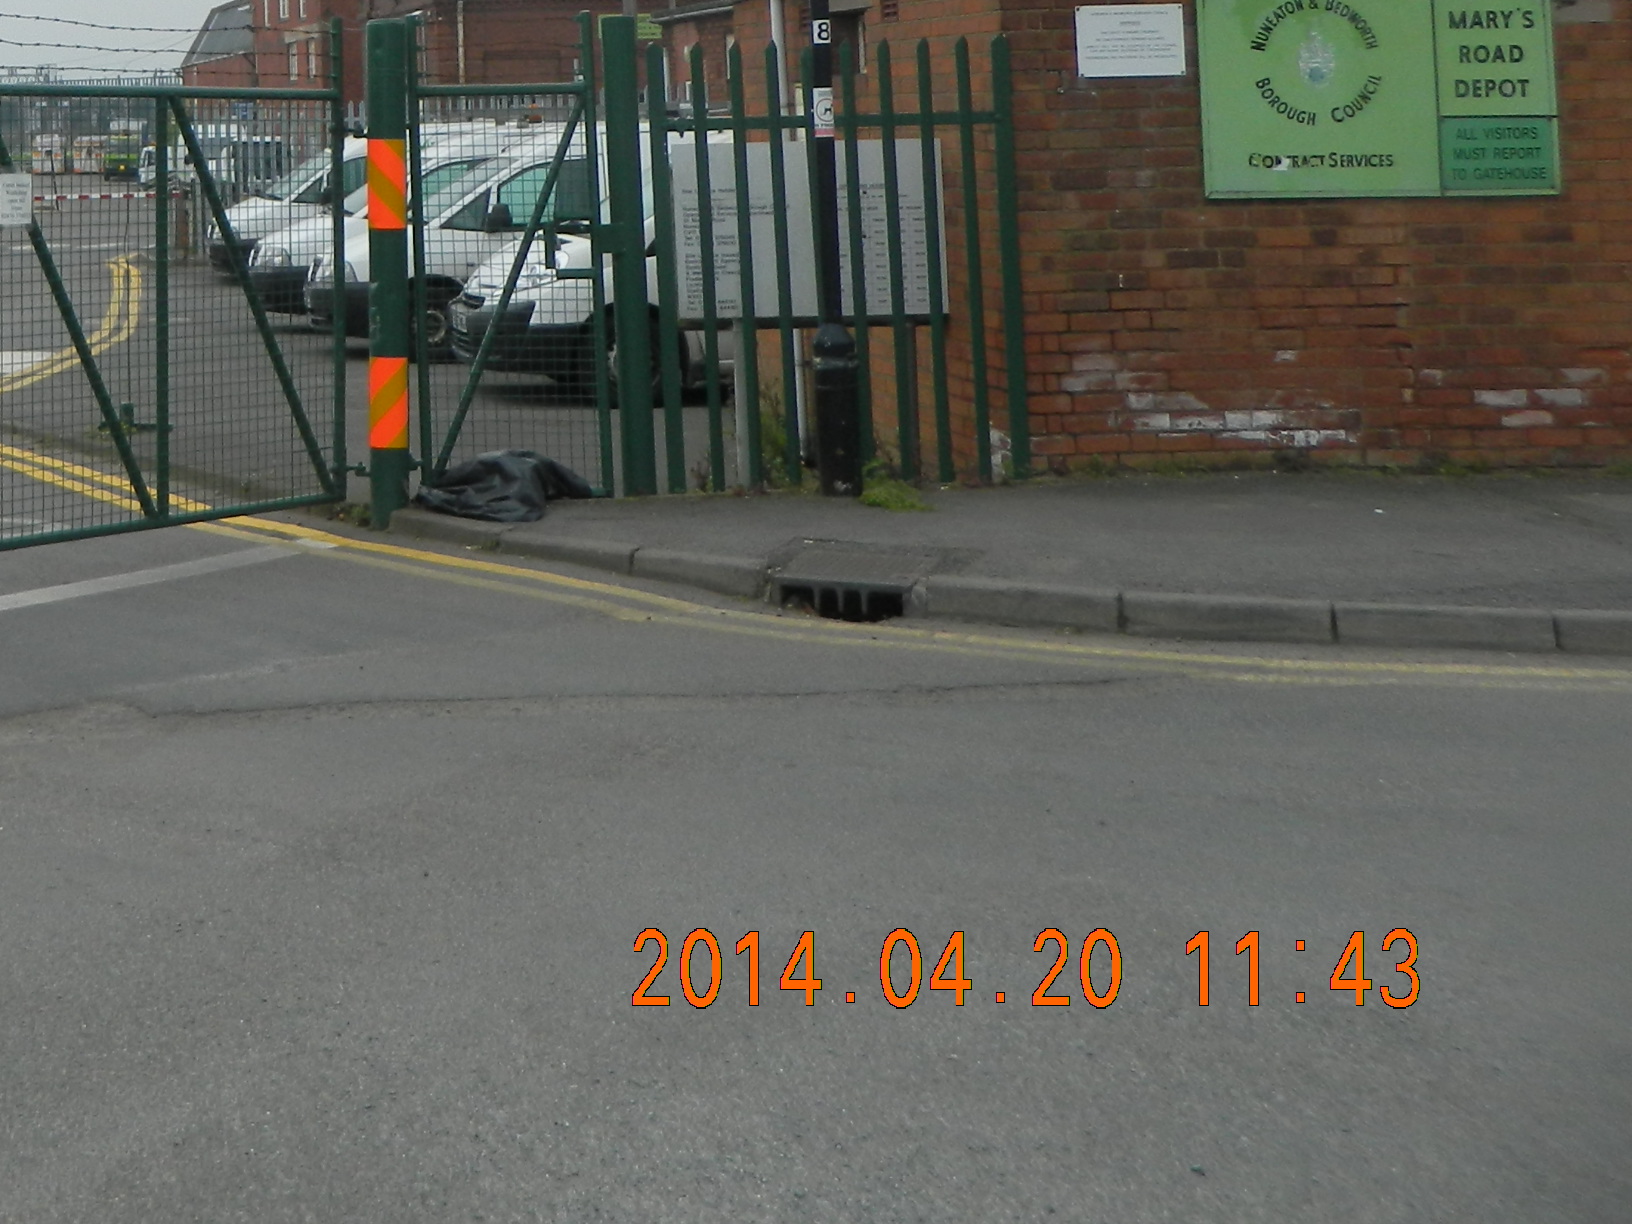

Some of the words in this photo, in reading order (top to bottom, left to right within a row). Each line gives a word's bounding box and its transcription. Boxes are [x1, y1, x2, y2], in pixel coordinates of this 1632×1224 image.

[1448, 7, 1535, 29] MARY'S
[817, 22, 830, 41] 8
[1459, 44, 1524, 64] ROAD
[1454, 78, 1530, 98] DEPOT
[1255, 77, 1317, 126] BOROUGH
[1331, 75, 1382, 124] COUNCIL
[1455, 127, 1478, 141] ALL
[1482, 126, 1538, 140] VISITORS
[1328, 152, 1394, 168] SERVICES
[1452, 147, 1487, 160] MUST
[1493, 146, 1542, 160] REPORT
[1452, 167, 1466, 180] TO
[1473, 167, 1547, 180] GATEHOUSE
